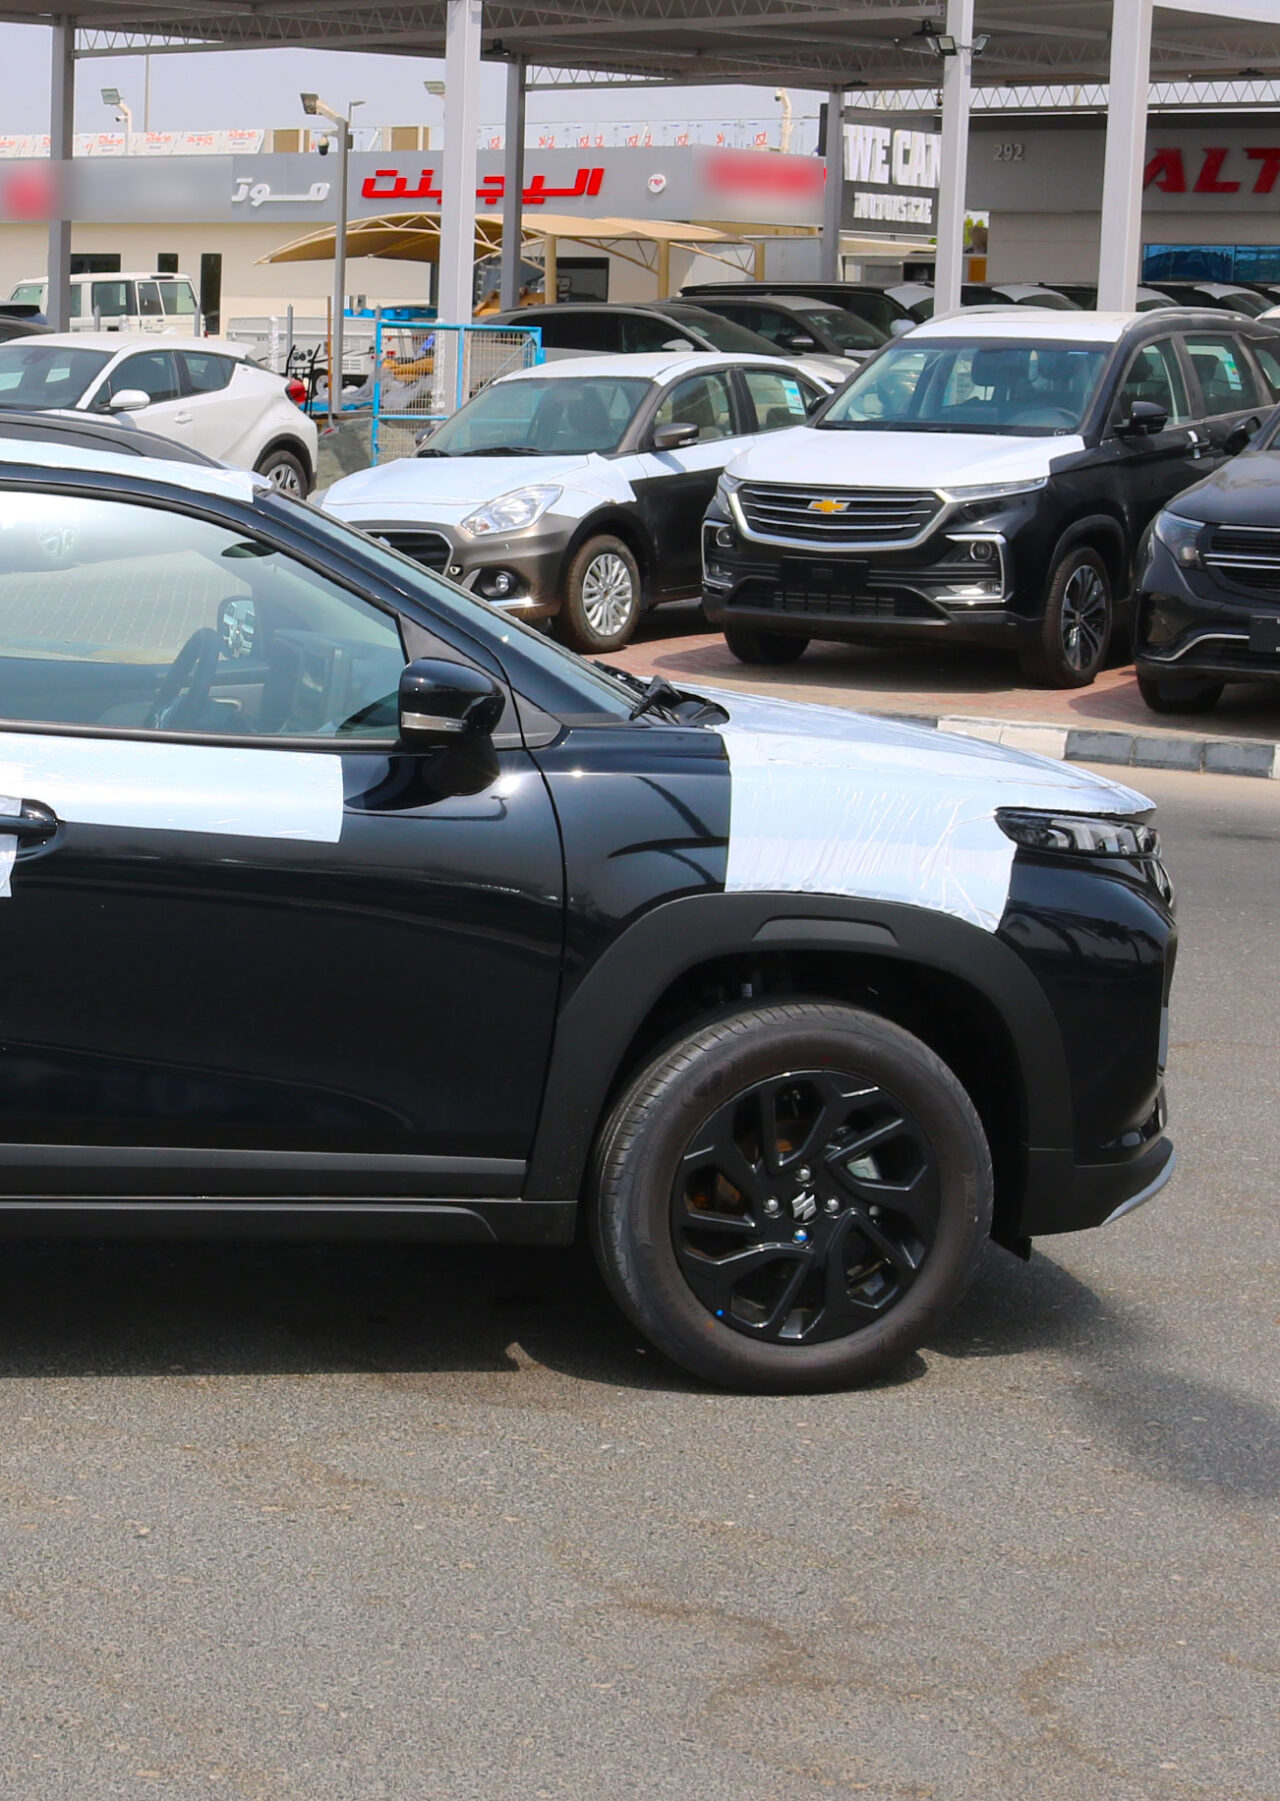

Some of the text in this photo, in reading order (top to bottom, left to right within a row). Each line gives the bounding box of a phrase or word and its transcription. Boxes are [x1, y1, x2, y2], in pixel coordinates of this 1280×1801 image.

[843, 123, 891, 185] WE
[892, 129, 942, 188] CAN
[992, 143, 1025, 161] 292
